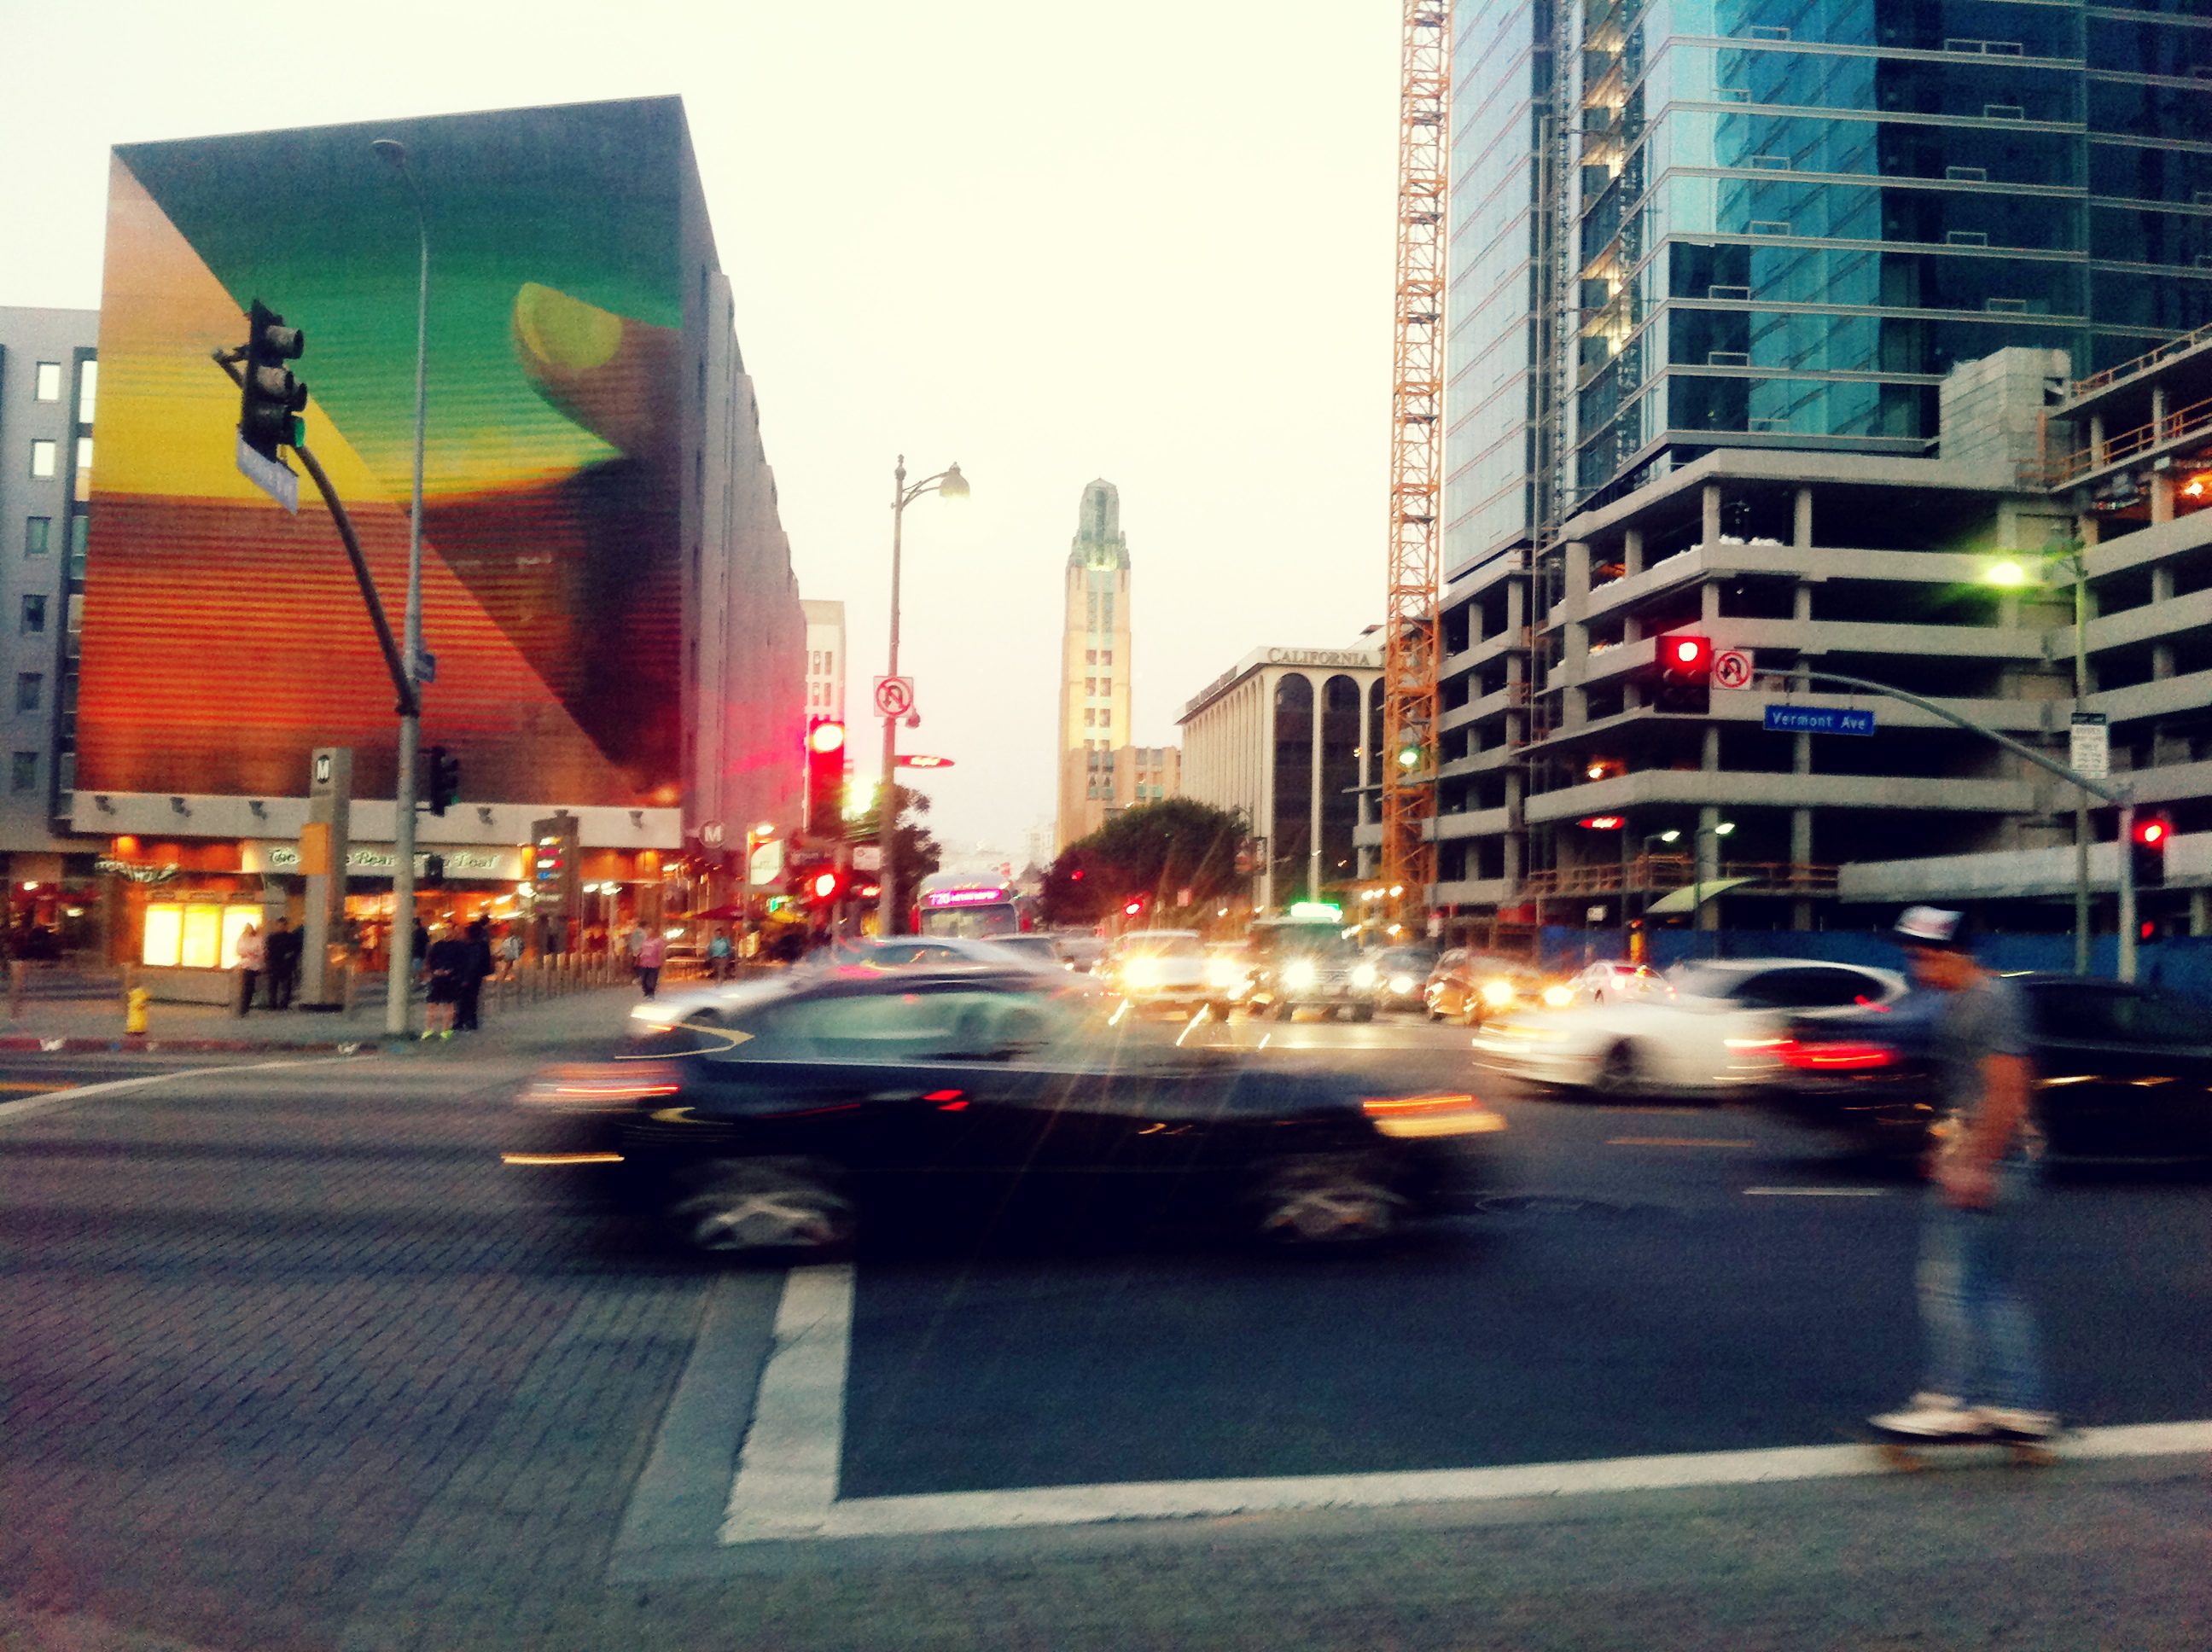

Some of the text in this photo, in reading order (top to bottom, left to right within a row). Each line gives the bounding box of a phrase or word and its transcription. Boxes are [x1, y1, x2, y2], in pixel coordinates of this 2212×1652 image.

[1267, 647, 1370, 666] CALIFORNIA
[1773, 712, 1866, 730] Vermont Ave
[704, 825, 723, 842] M
